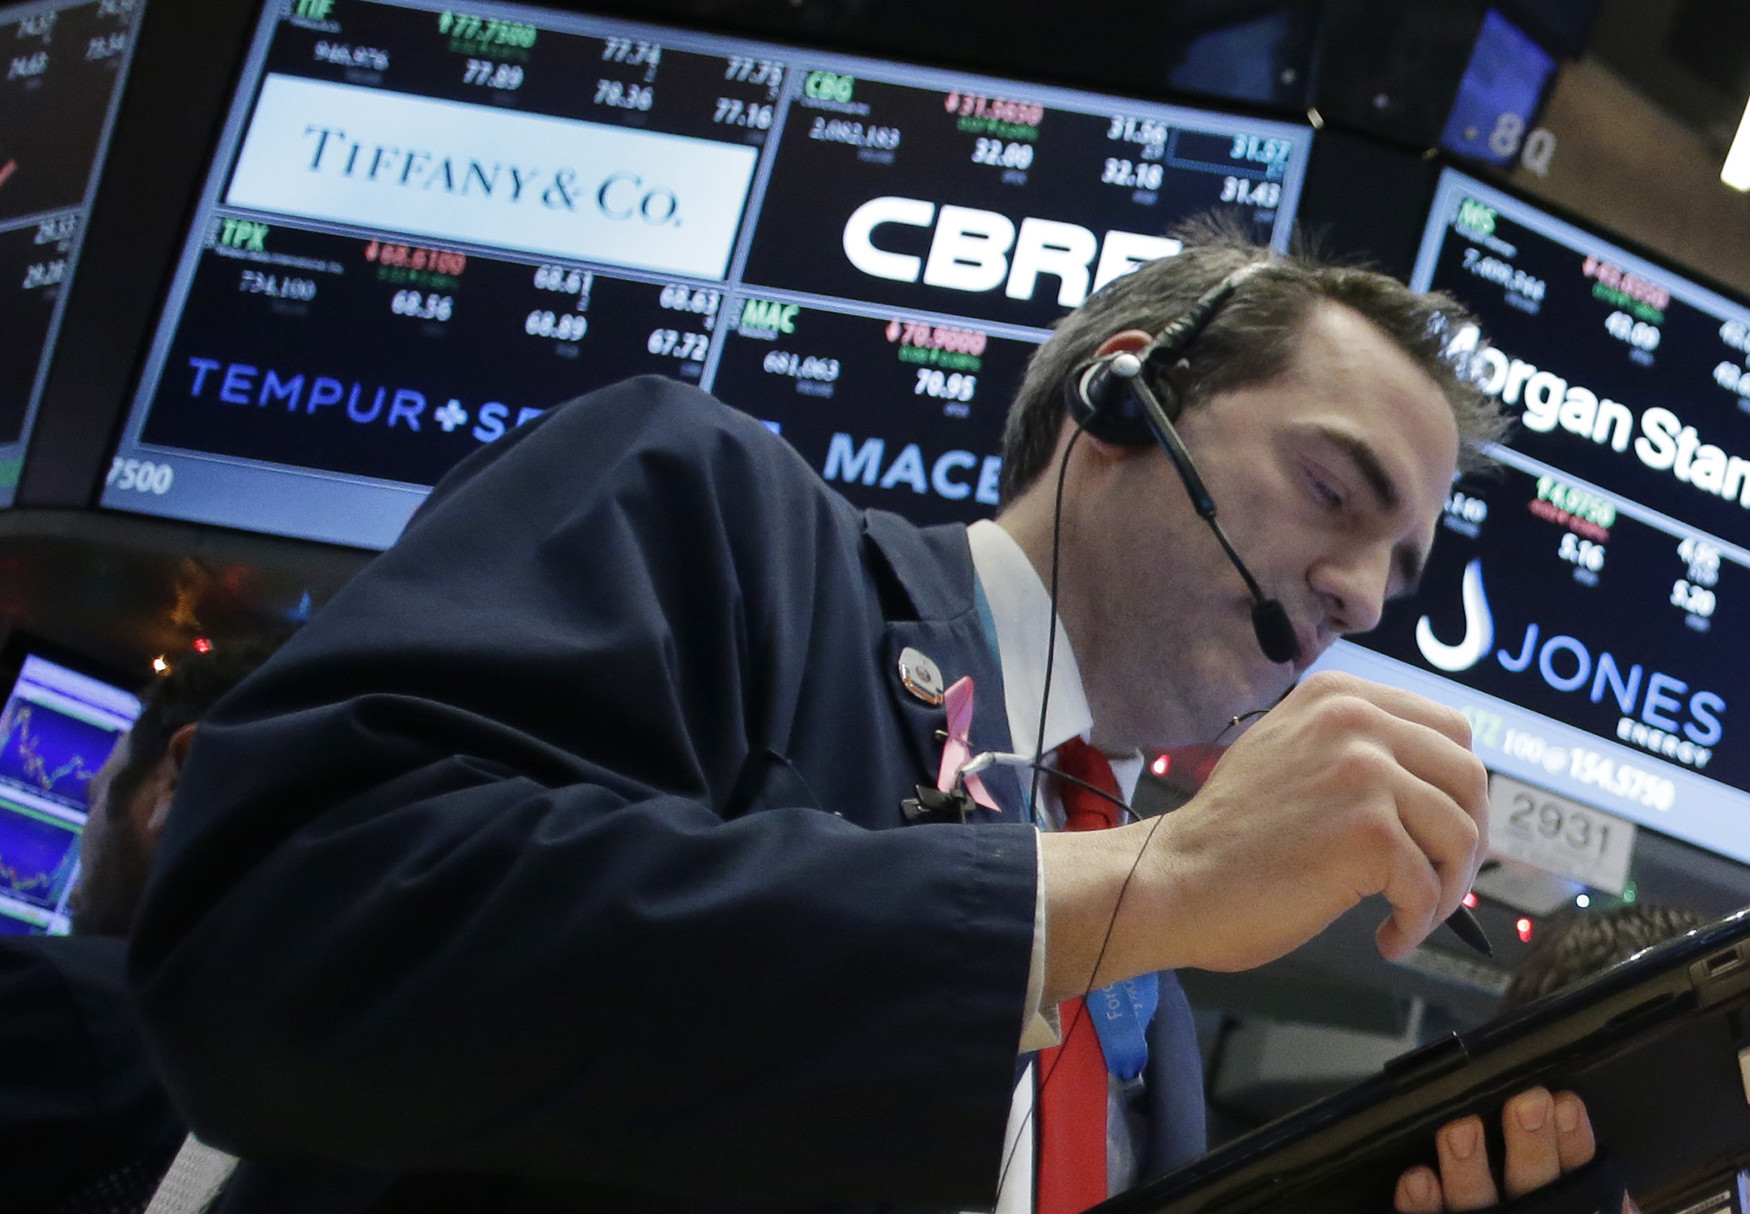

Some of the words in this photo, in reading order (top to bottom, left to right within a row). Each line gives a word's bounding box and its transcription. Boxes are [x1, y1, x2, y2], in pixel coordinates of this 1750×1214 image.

[305, 125, 529, 202] TIFFANY
[221, 217, 270, 251] TPX
[843, 196, 1184, 308] CBRE
[742, 298, 800, 334] MAC
[1497, 623, 1726, 746] JONES
[1617, 717, 1712, 768] ENERGY
[1509, 792, 1611, 855] 2931
